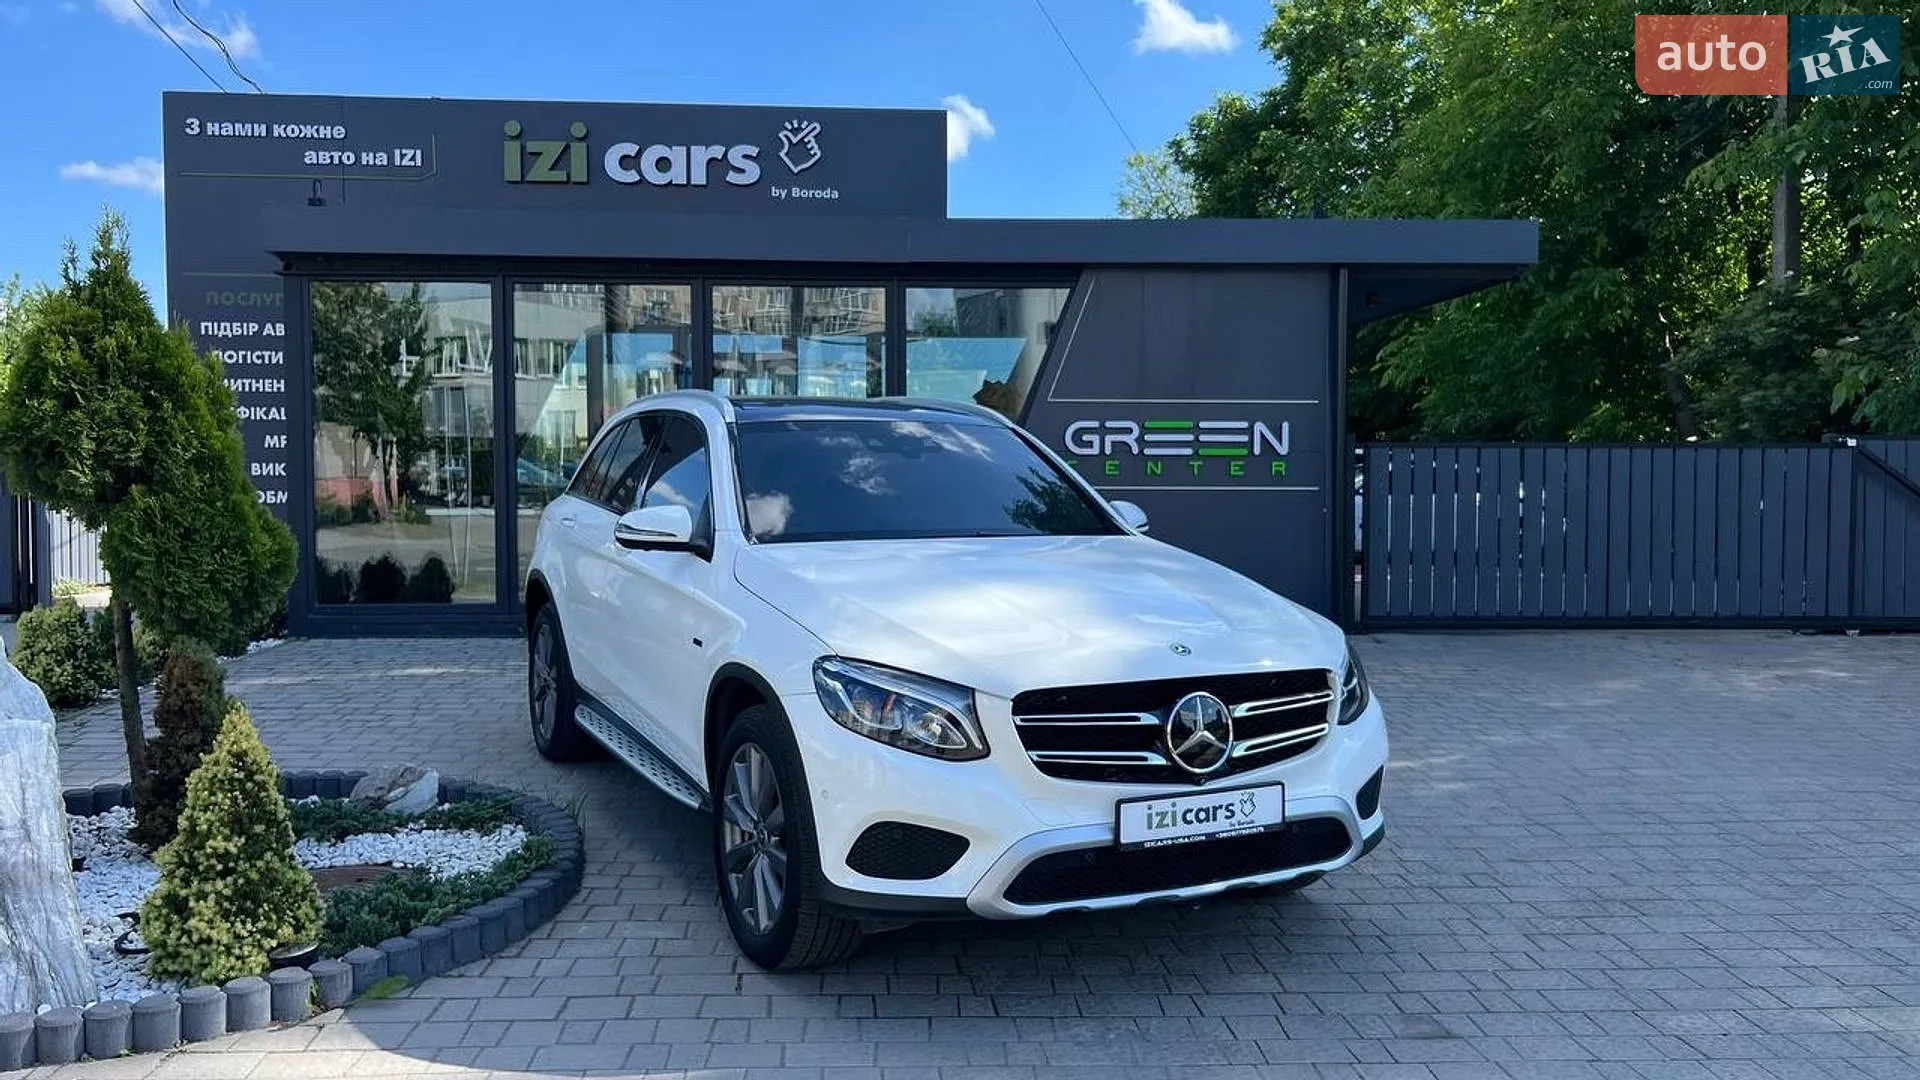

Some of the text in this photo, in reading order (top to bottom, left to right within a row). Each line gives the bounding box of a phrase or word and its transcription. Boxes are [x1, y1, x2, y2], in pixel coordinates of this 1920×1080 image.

[206, 121, 267, 137] нами
[272, 123, 347, 139] кожне
[303, 149, 422, 167] авто на IZI
[503, 120, 761, 186] izi cars
[771, 186, 839, 200] by Boroda
[200, 321, 259, 338] ПІДБІР
[1064, 421, 1289, 456] GREEN
[250, 462, 287, 476] ВИК
[1146, 801, 1236, 830] izi cars
